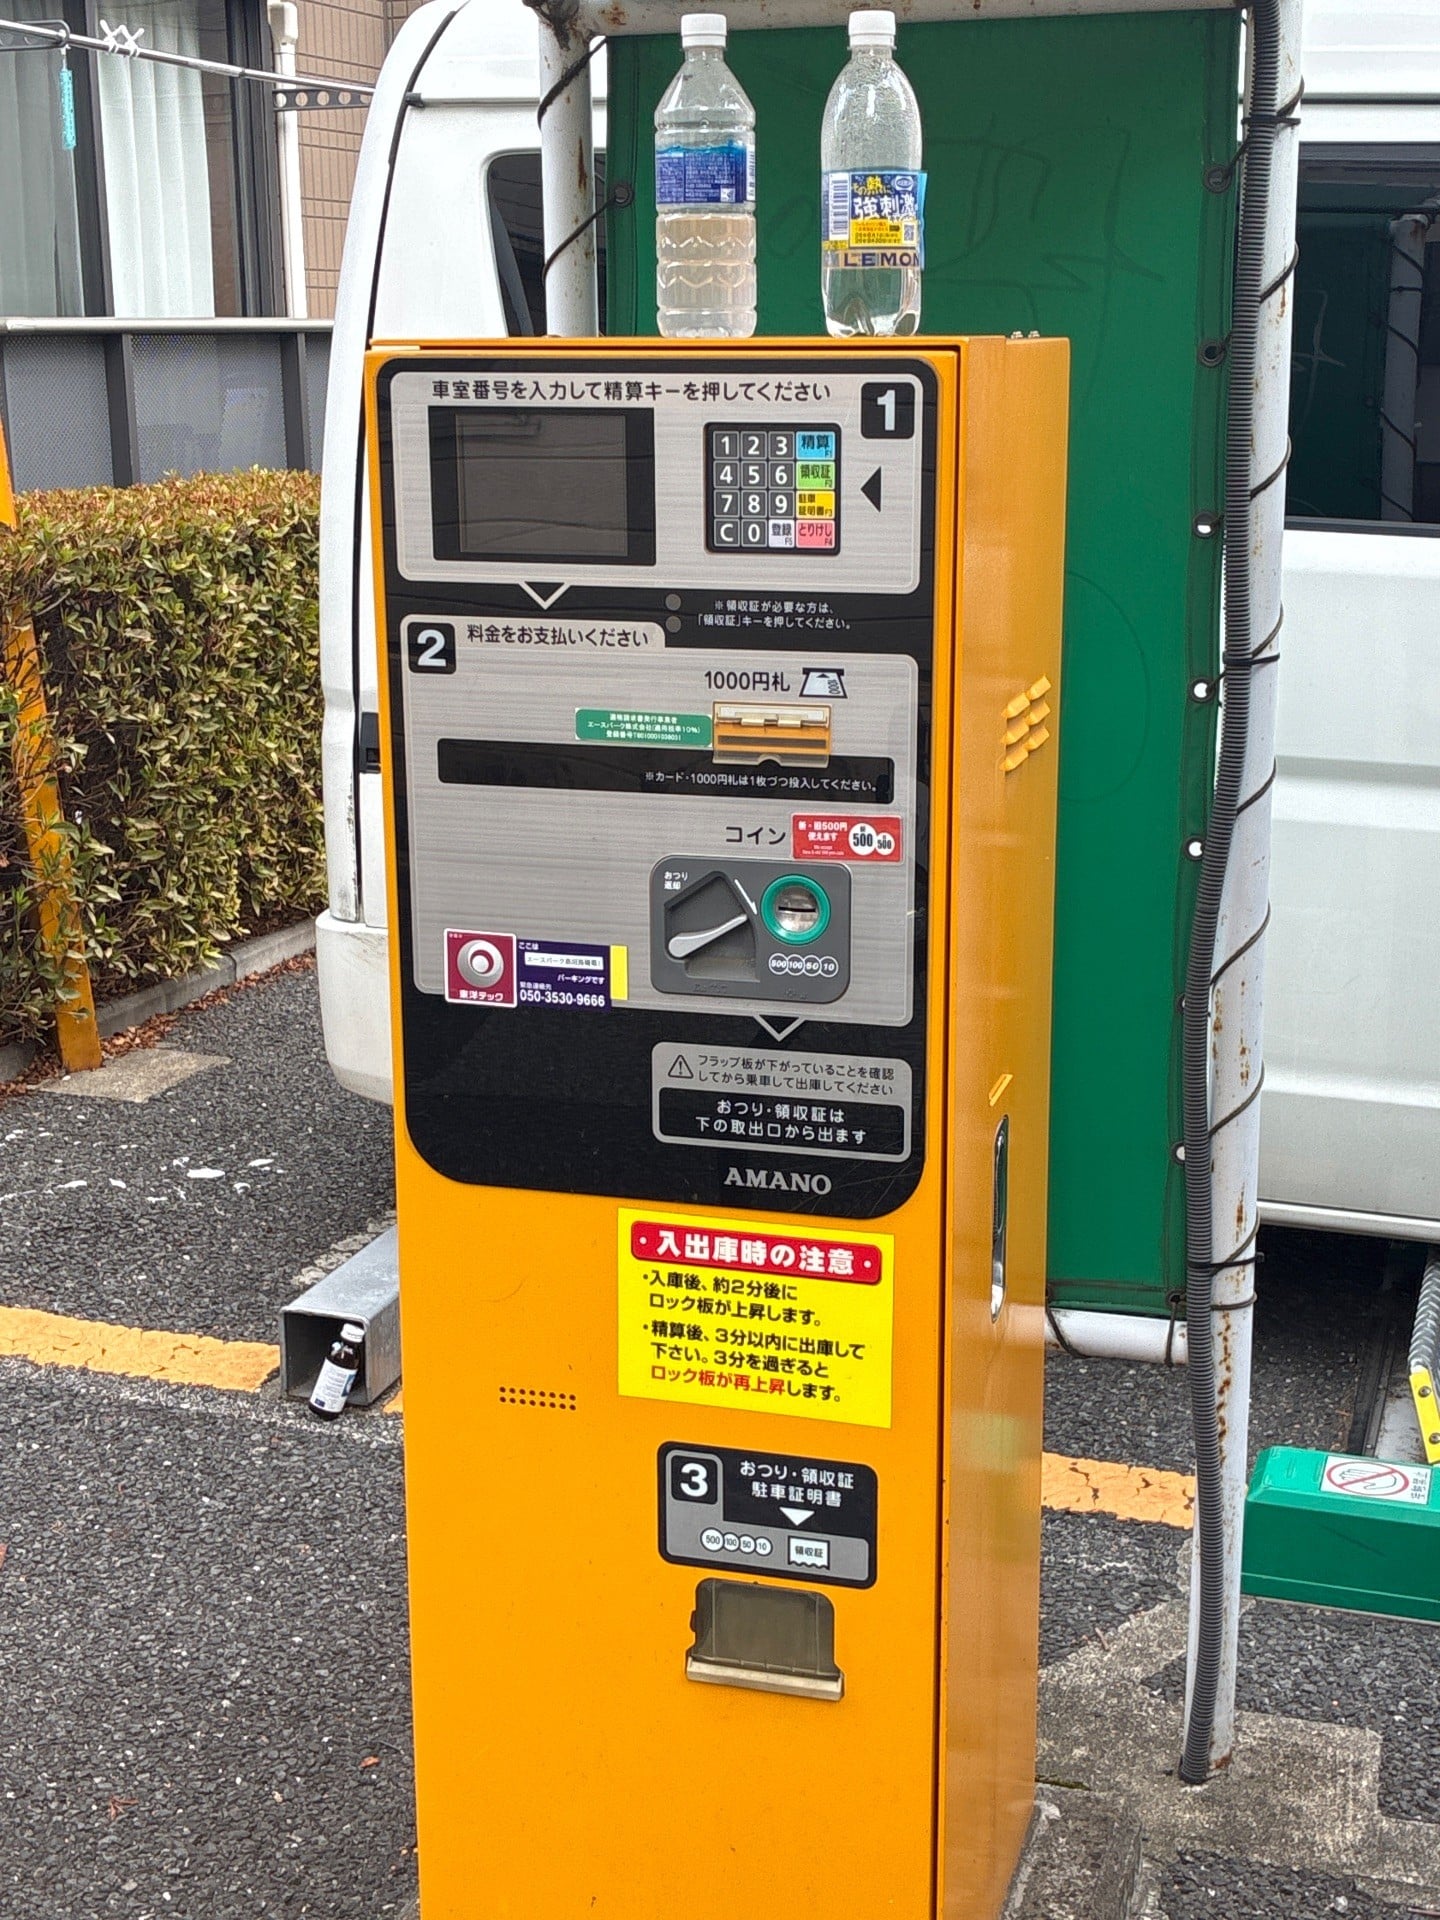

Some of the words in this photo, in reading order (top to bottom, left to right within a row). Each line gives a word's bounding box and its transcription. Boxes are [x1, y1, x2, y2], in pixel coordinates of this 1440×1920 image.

[431, 379, 831, 403] 車室番号を入力して精算キーを押してください
[876, 389, 897, 431] 1
[721, 435, 730, 455] 1
[747, 436, 760, 455] 2
[775, 436, 788, 455] 3
[719, 465, 733, 484] 4
[748, 466, 760, 484] 5
[775, 465, 788, 484] 6
[721, 494, 733, 513] 7
[748, 494, 760, 513] 8
[775, 494, 788, 513] 9
[720, 523, 733, 542] C
[748, 523, 760, 542] 0
[799, 523, 832, 537] とりけし
[467, 624, 648, 648] 料金をお支払いください
[416, 629, 447, 667] 2
[704, 670, 790, 692] 1000円札
[726, 826, 786, 845] コイン
[853, 833, 873, 847] 500
[877, 838, 892, 850] 500
[664, 871, 688, 881] おつり
[518, 942, 539, 950] ここは
[771, 959, 787, 968] 500
[789, 961, 803, 969] 100
[805, 962, 819, 970] 50
[823, 963, 835, 971] 10
[557, 974, 605, 985] パーキングです
[519, 989, 605, 1007] 050-3530-9666
[698, 1055, 895, 1081] フラップ板が下がっていることを確認
[698, 1070, 893, 1095] してから乗車して出庫してください
[716, 1099, 845, 1122] おつり・領収証は
[695, 1115, 867, 1145] 下の取出口から出ます
[723, 1166, 832, 1195] AMANO
[649, 1293, 821, 1326] ロック板が上昇します。
[651, 1365, 841, 1402] ロック板が再上昇します。
[680, 1462, 708, 1497] 3
[739, 1460, 854, 1490] おつり・領収証
[751, 1481, 842, 1508] 駐車証明書
[705, 1534, 721, 1545] 500
[725, 1538, 737, 1547] 100
[742, 1539, 752, 1549] 50
[758, 1542, 767, 1551] 10
